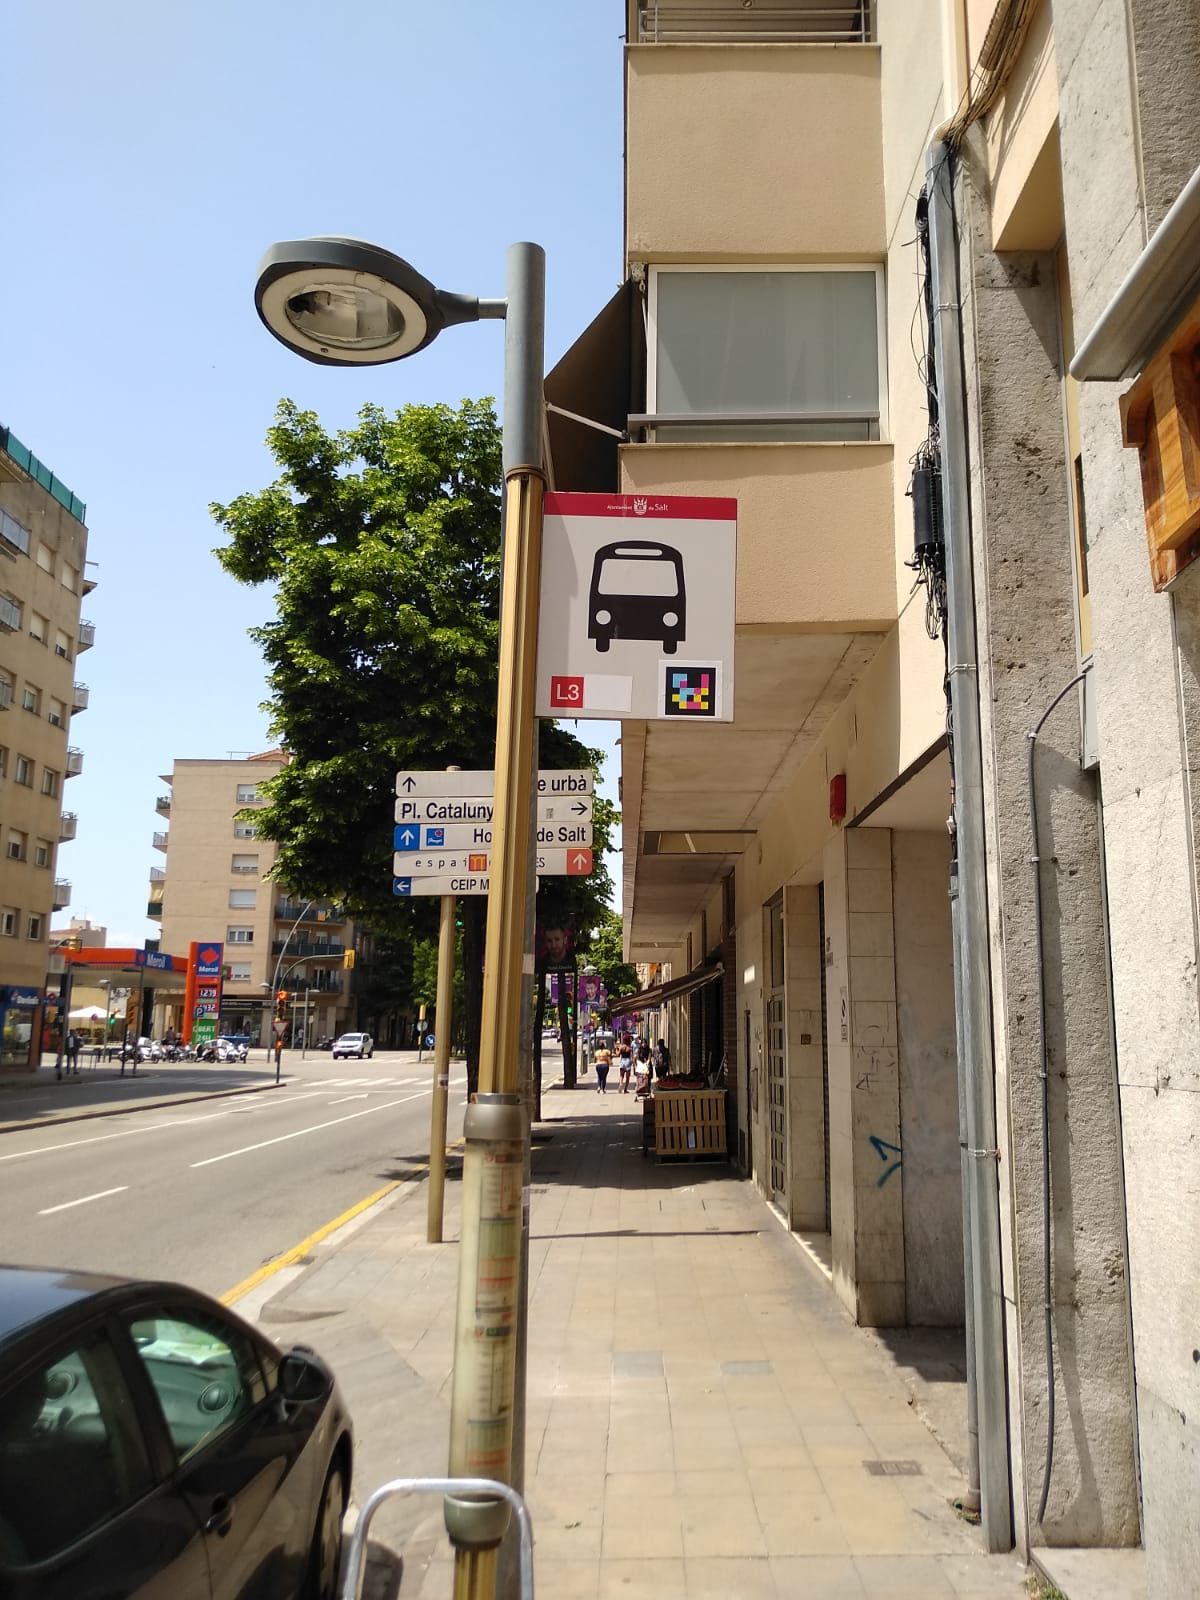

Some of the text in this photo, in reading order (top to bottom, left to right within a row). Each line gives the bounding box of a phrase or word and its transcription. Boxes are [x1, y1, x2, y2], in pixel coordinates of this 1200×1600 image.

[655, 503, 668, 511] Salt
[556, 683, 580, 701] L3
[551, 774, 587, 792] urbà
[401, 802, 494, 822] Pl. Cataluny
[537, 826, 587, 842] de Salt
[415, 857, 467, 870] espai
[450, 878, 477, 891] CEIP
